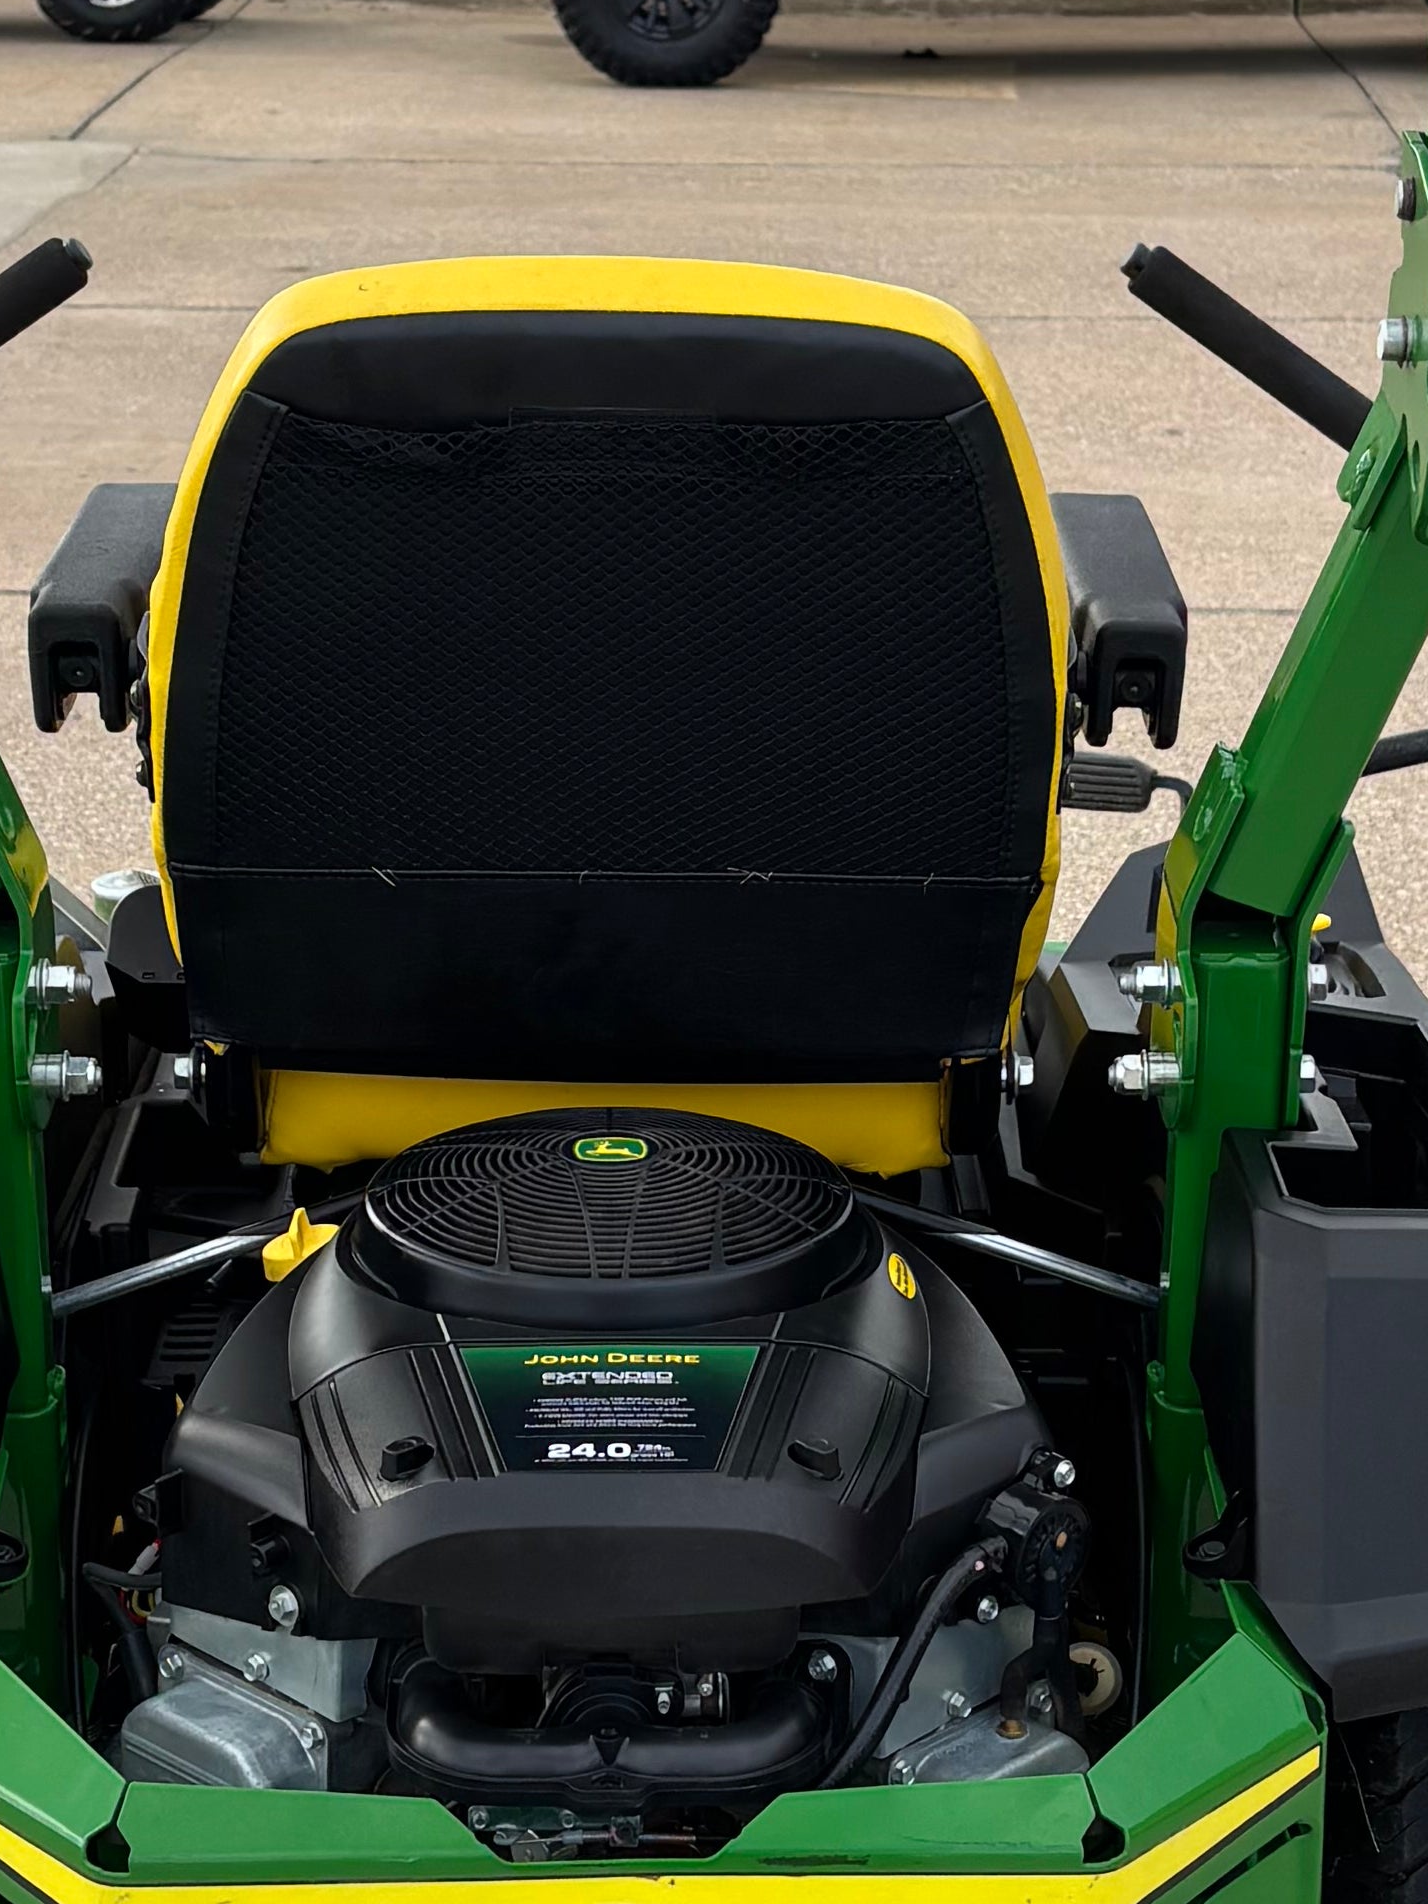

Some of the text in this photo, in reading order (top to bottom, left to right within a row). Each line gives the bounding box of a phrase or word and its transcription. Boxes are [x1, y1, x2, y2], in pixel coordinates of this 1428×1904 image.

[524, 1352, 701, 1365] JOHN DEERE
[548, 1442, 632, 1459] 24.0
